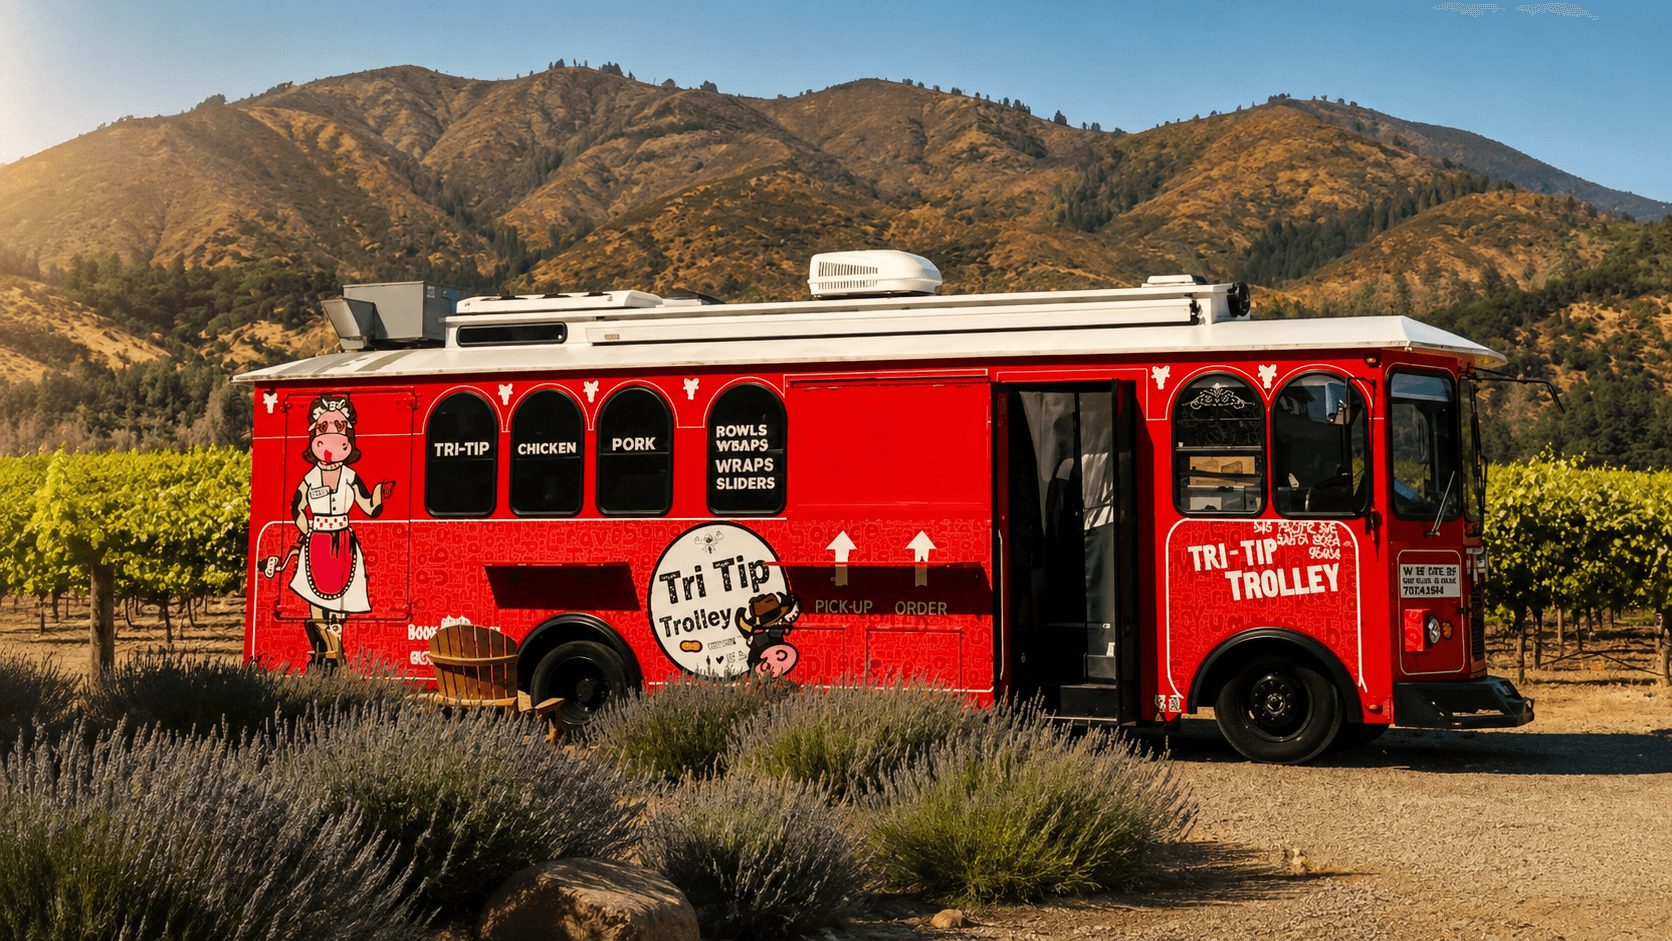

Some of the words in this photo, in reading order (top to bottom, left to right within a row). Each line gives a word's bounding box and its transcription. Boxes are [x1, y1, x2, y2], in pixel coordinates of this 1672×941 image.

[434, 441, 490, 457] TRI-TIP
[517, 442, 577, 455] CHICKEN
[612, 437, 656, 451] PORK
[715, 457, 774, 473] WRAPS
[716, 476, 776, 490] SLIDERS
[1187, 538, 1278, 572] TRI-TIP
[659, 564, 706, 604] Tri
[712, 555, 770, 593] Tip
[1224, 563, 1340, 601] TROLLEY
[815, 600, 873, 614] PICK-UP
[895, 601, 948, 615] ORDER
[659, 608, 731, 637] Trolley
